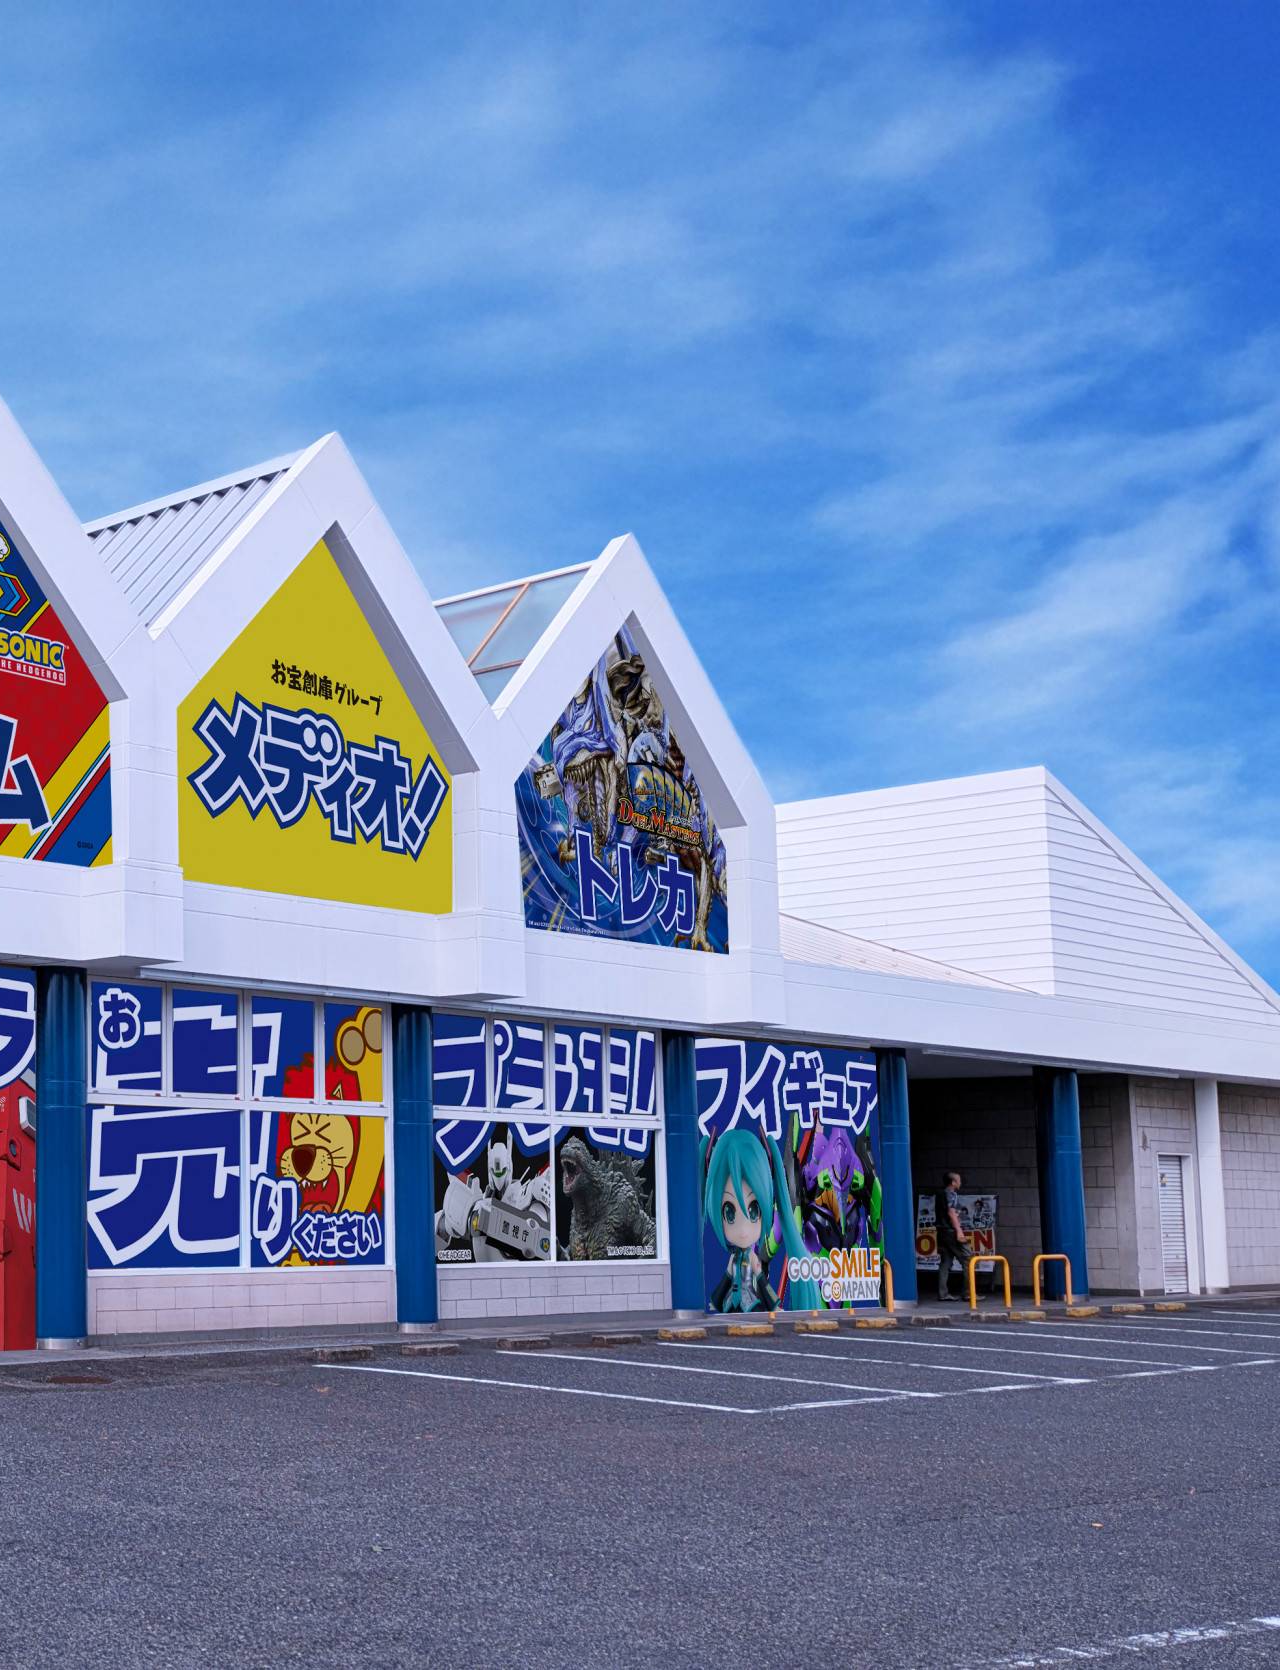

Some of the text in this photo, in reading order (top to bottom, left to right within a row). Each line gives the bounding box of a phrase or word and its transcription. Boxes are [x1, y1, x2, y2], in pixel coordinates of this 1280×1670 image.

[16, 662, 65, 682] HEDGEHOG
[270, 658, 384, 716] お宝創庫グループ
[575, 828, 696, 936] トレカ
[788, 1248, 880, 1281] GOOD SMILE
[822, 1280, 880, 1301] COMPANY
